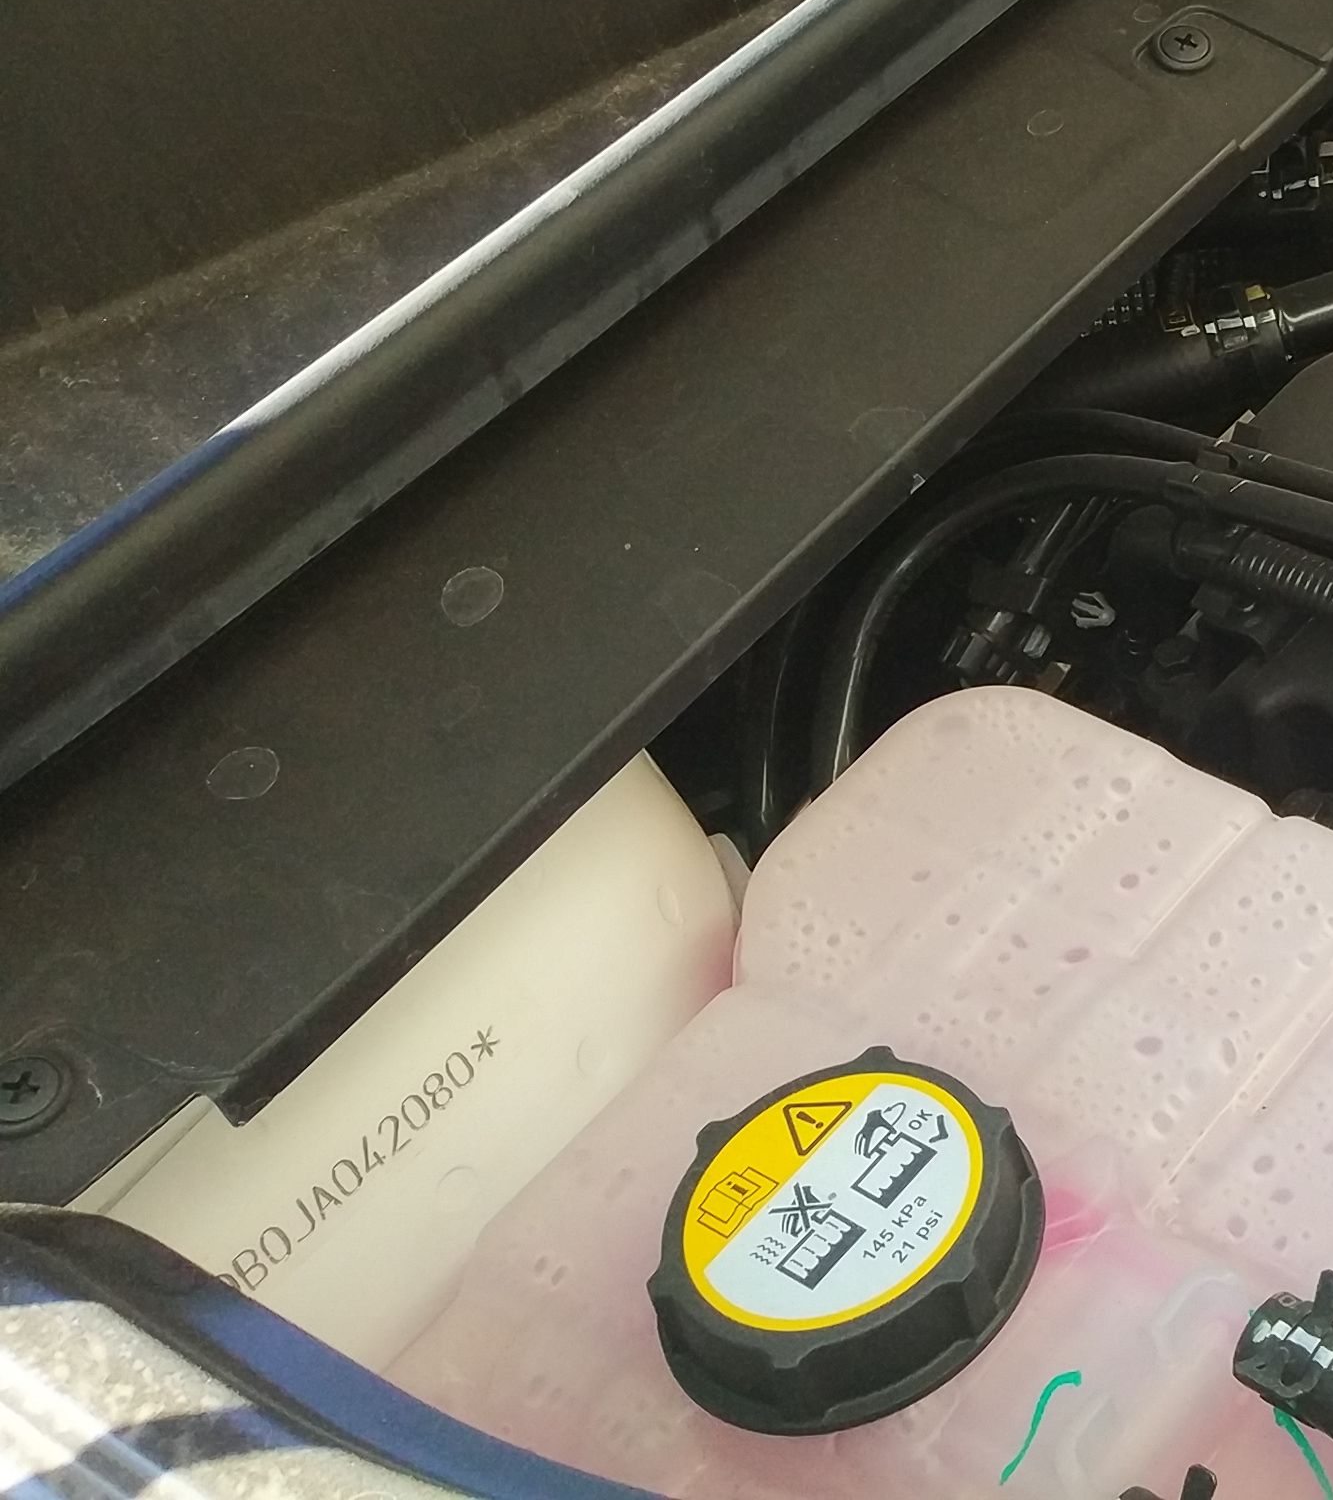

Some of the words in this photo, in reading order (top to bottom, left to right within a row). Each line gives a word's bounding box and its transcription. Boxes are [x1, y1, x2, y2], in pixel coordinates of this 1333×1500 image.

[908, 1108, 933, 1132] OK
[862, 1229, 894, 1261] 145
[894, 1194, 928, 1231] kPa
[891, 1239, 915, 1264] 21
[915, 1210, 945, 1240] psi
